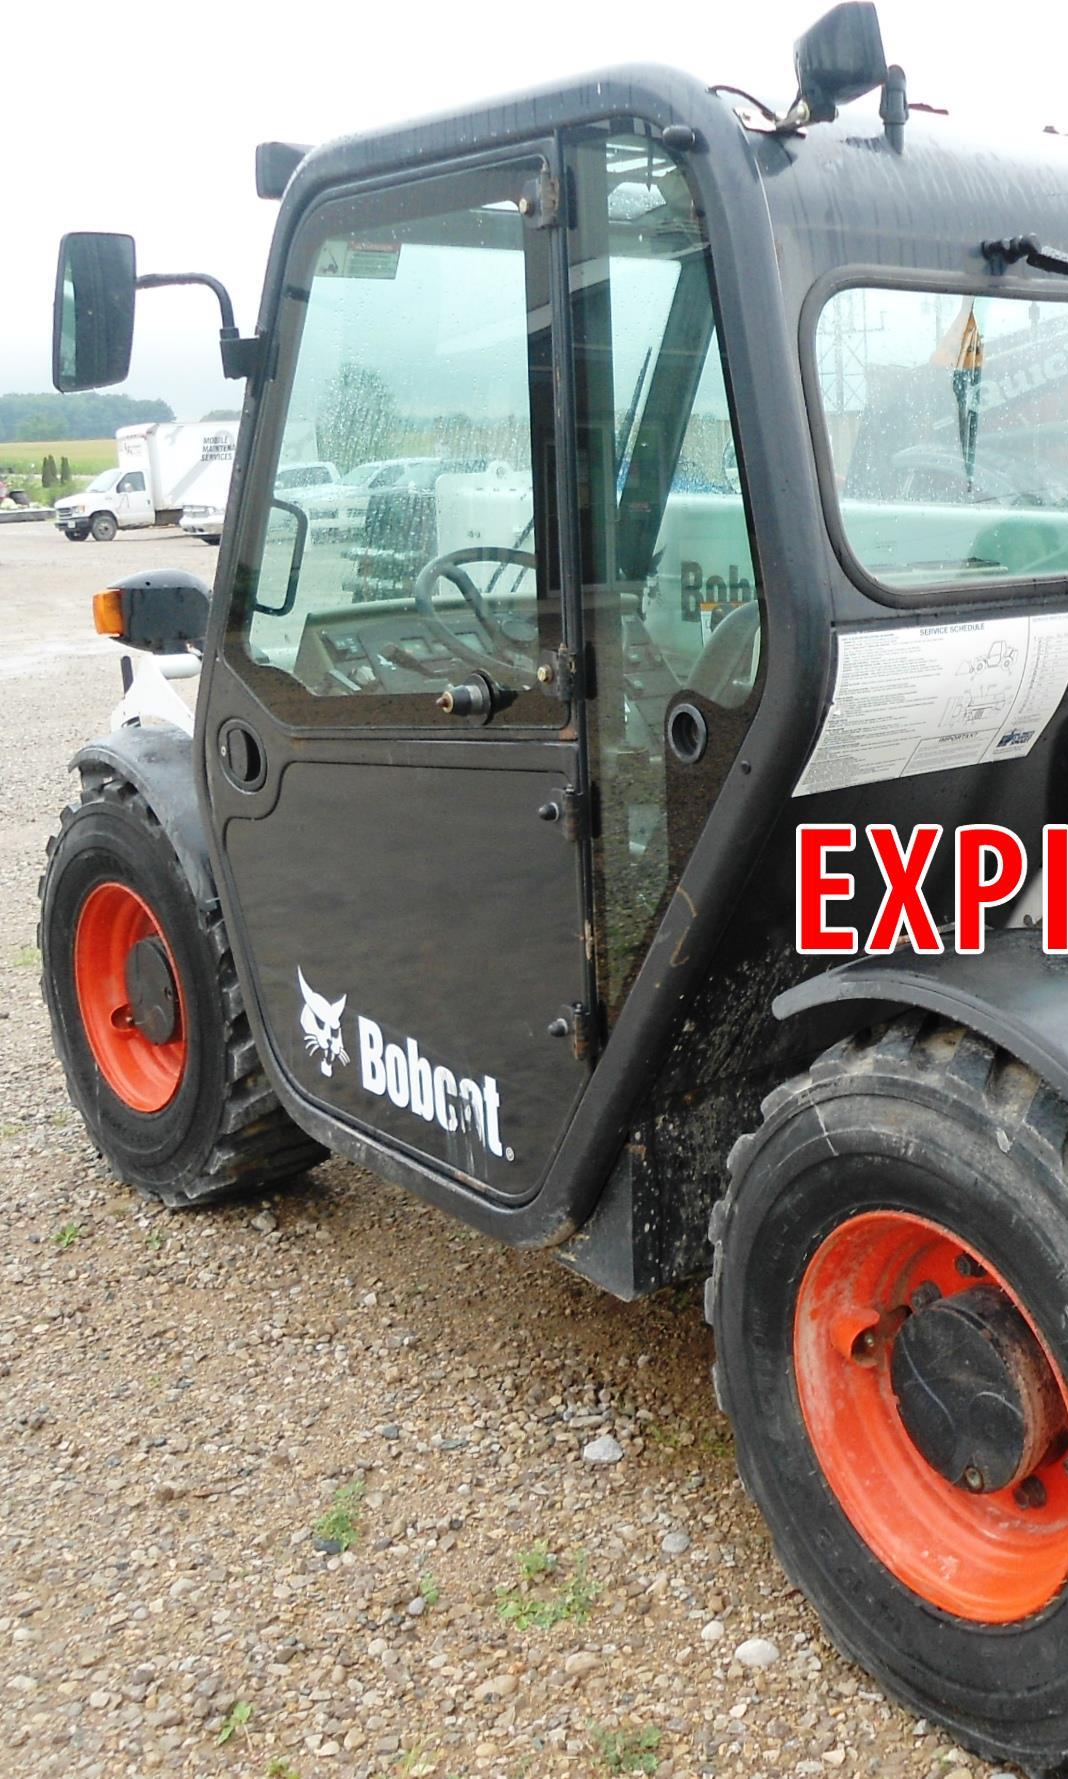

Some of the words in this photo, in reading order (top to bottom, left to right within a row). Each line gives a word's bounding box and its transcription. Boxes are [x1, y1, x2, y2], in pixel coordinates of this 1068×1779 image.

[201, 453, 232, 462] SERVICES
[920, 625, 948, 636] SERVICE
[949, 622, 986, 634] SCHEDULE
[358, 1015, 505, 1158] Bobcat
